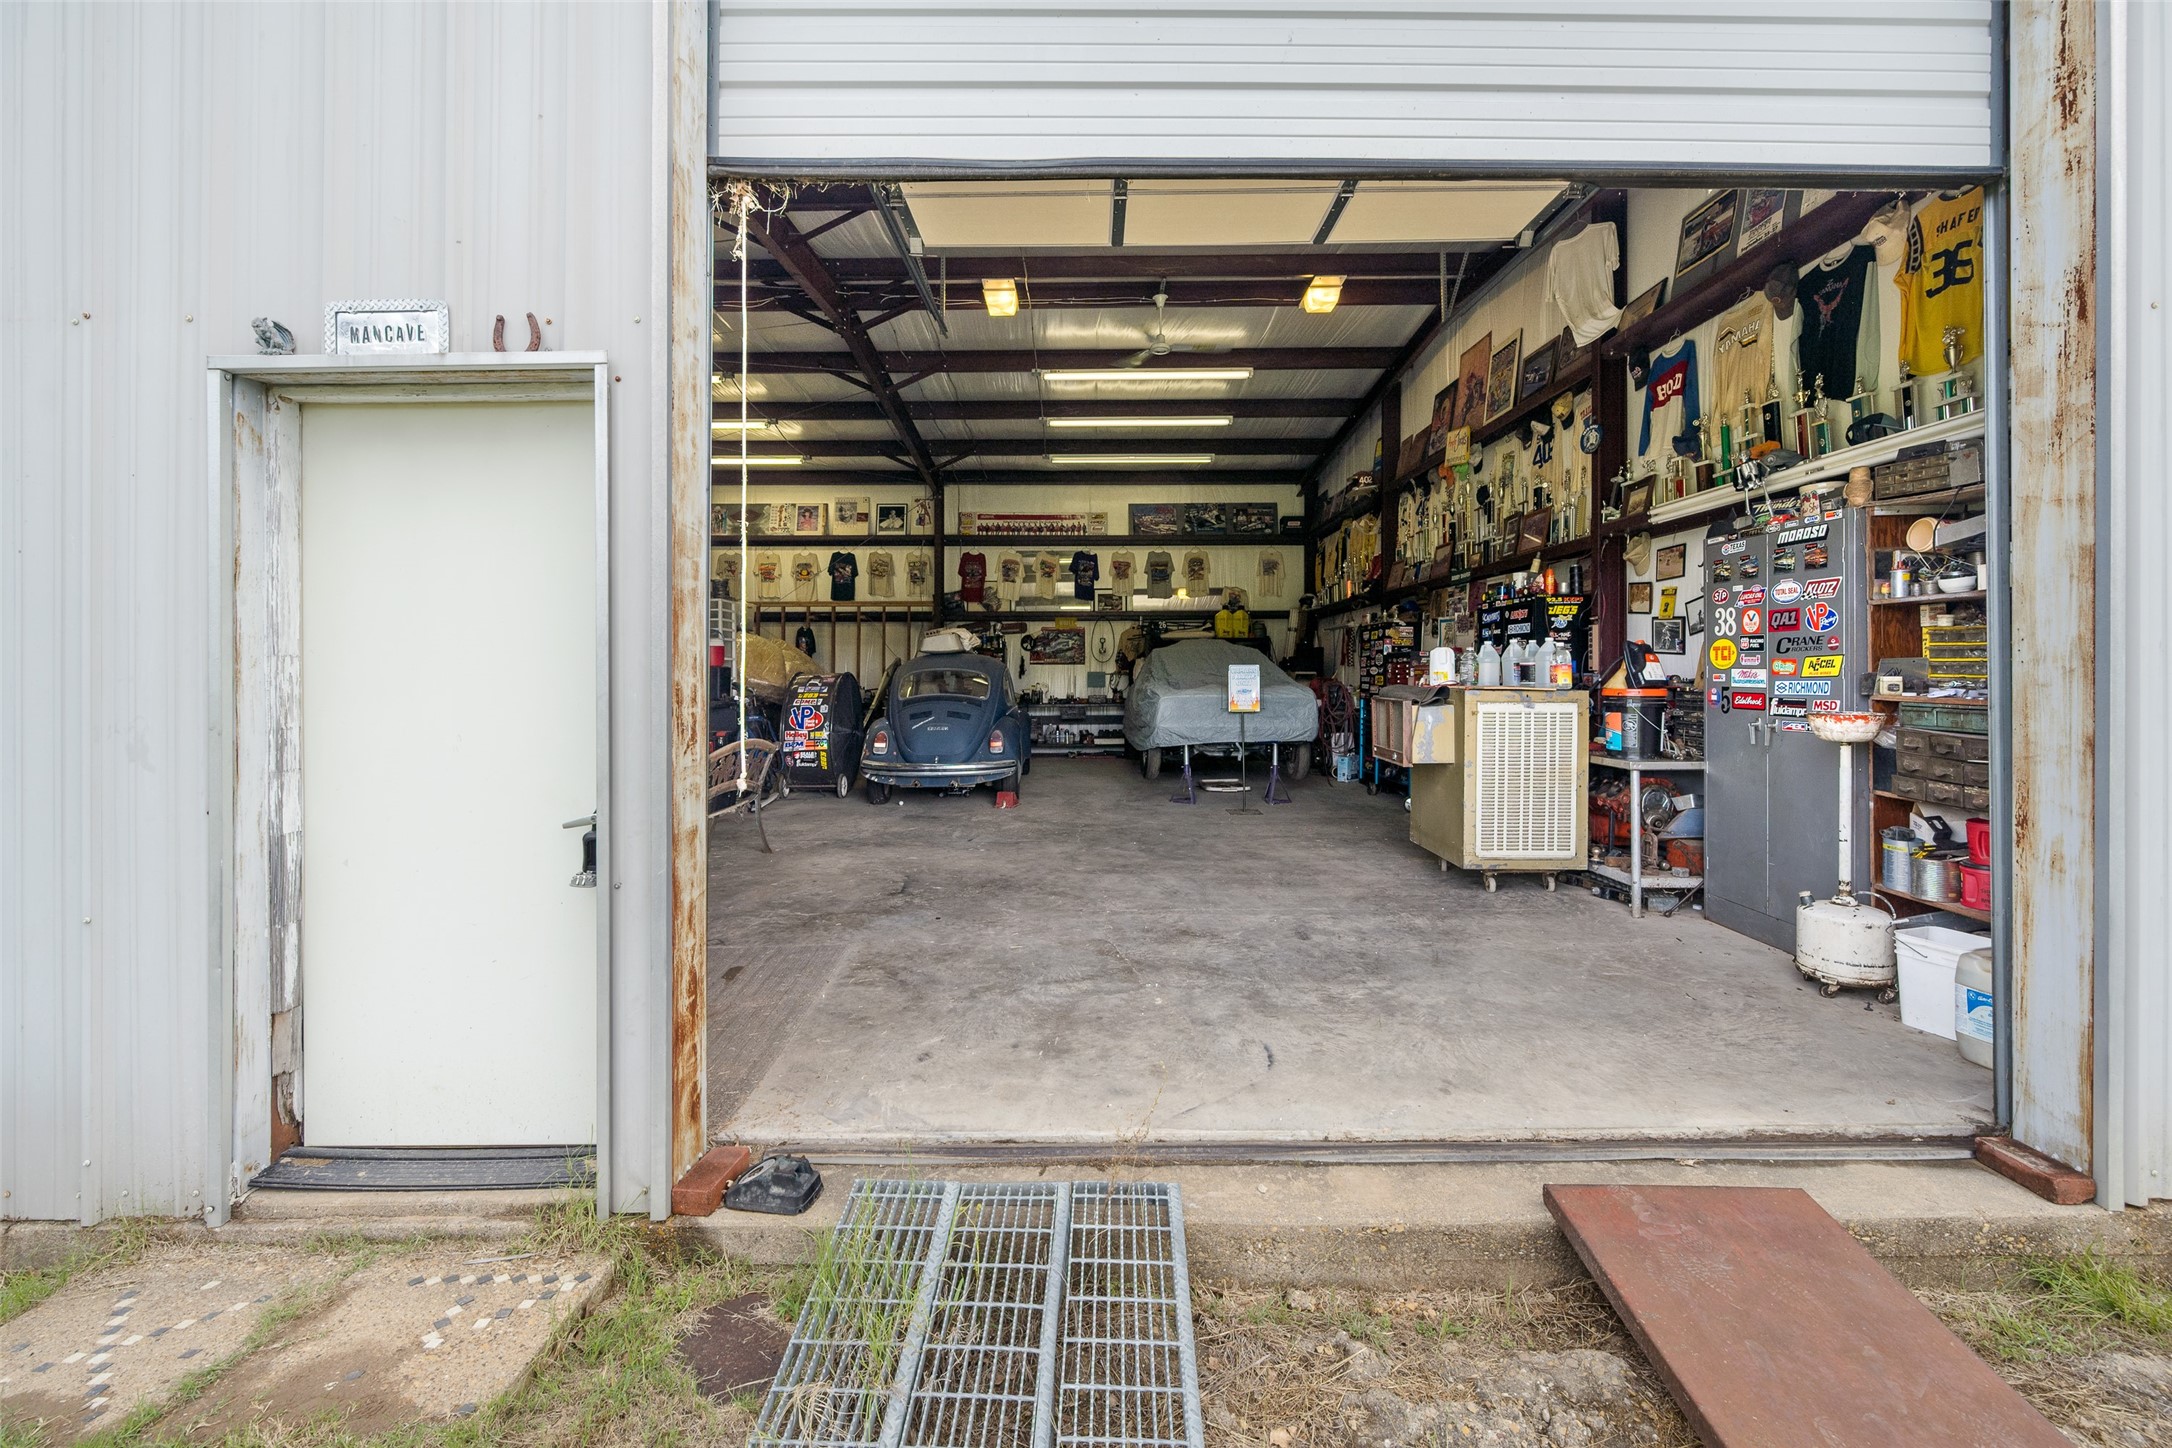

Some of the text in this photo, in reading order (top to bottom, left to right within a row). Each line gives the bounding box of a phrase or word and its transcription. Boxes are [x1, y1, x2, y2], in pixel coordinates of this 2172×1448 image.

[1925, 239, 1975, 299] 36
[350, 324, 426, 344] MANCAVE
[1777, 524, 1828, 545] MOROSO
[1729, 541, 1745, 551] TEXAS
[1787, 586, 1799, 595] SEAL
[1808, 581, 1838, 595] KLOTZ
[1714, 590, 1727, 602] STP
[1714, 607, 1737, 637] 38
[1770, 611, 1797, 629] QA1
[1806, 602, 1829, 631] VP
[1775, 635, 1826, 654] CRANE
[1712, 646, 1732, 661] TCI
[1808, 658, 1836, 672] ACCEL
[1787, 682, 1830, 694] RICHMOND
[1720, 686, 1731, 714] 5
[1734, 695, 1763, 706] Edelbrock
[1813, 701, 1838, 711] MSD
[791, 706, 815, 730] VP
[785, 731, 808, 740] Holley
